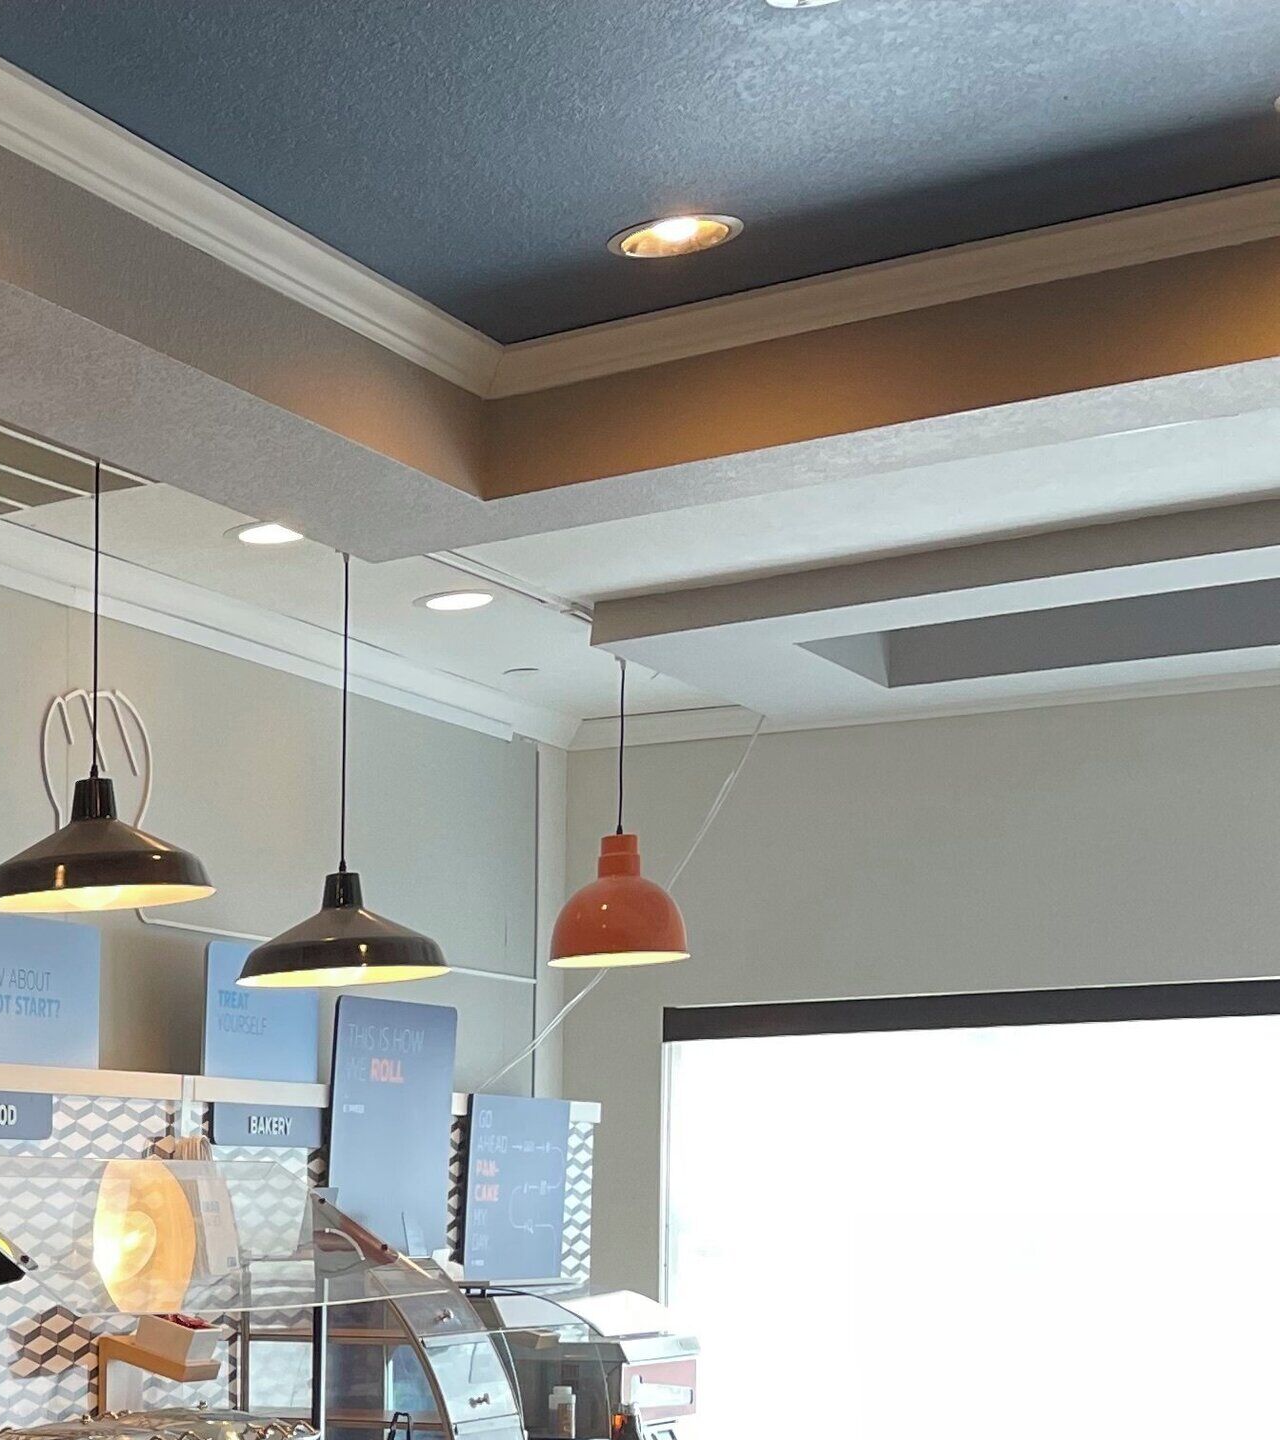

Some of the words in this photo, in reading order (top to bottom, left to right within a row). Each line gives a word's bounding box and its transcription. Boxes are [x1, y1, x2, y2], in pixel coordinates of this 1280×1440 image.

[9, 968, 51, 991] ABOUT
[15, 995, 61, 1018] START?
[217, 990, 249, 1009] TREAT
[217, 1013, 268, 1035] YOURSELF
[348, 1023, 375, 1050] THIS
[378, 1025, 389, 1052] IS
[393, 1028, 425, 1054] HOW
[370, 1056, 405, 1083] ROLL
[249, 1115, 292, 1136] BAKERY
[474, 1183, 500, 1202] CAKE
